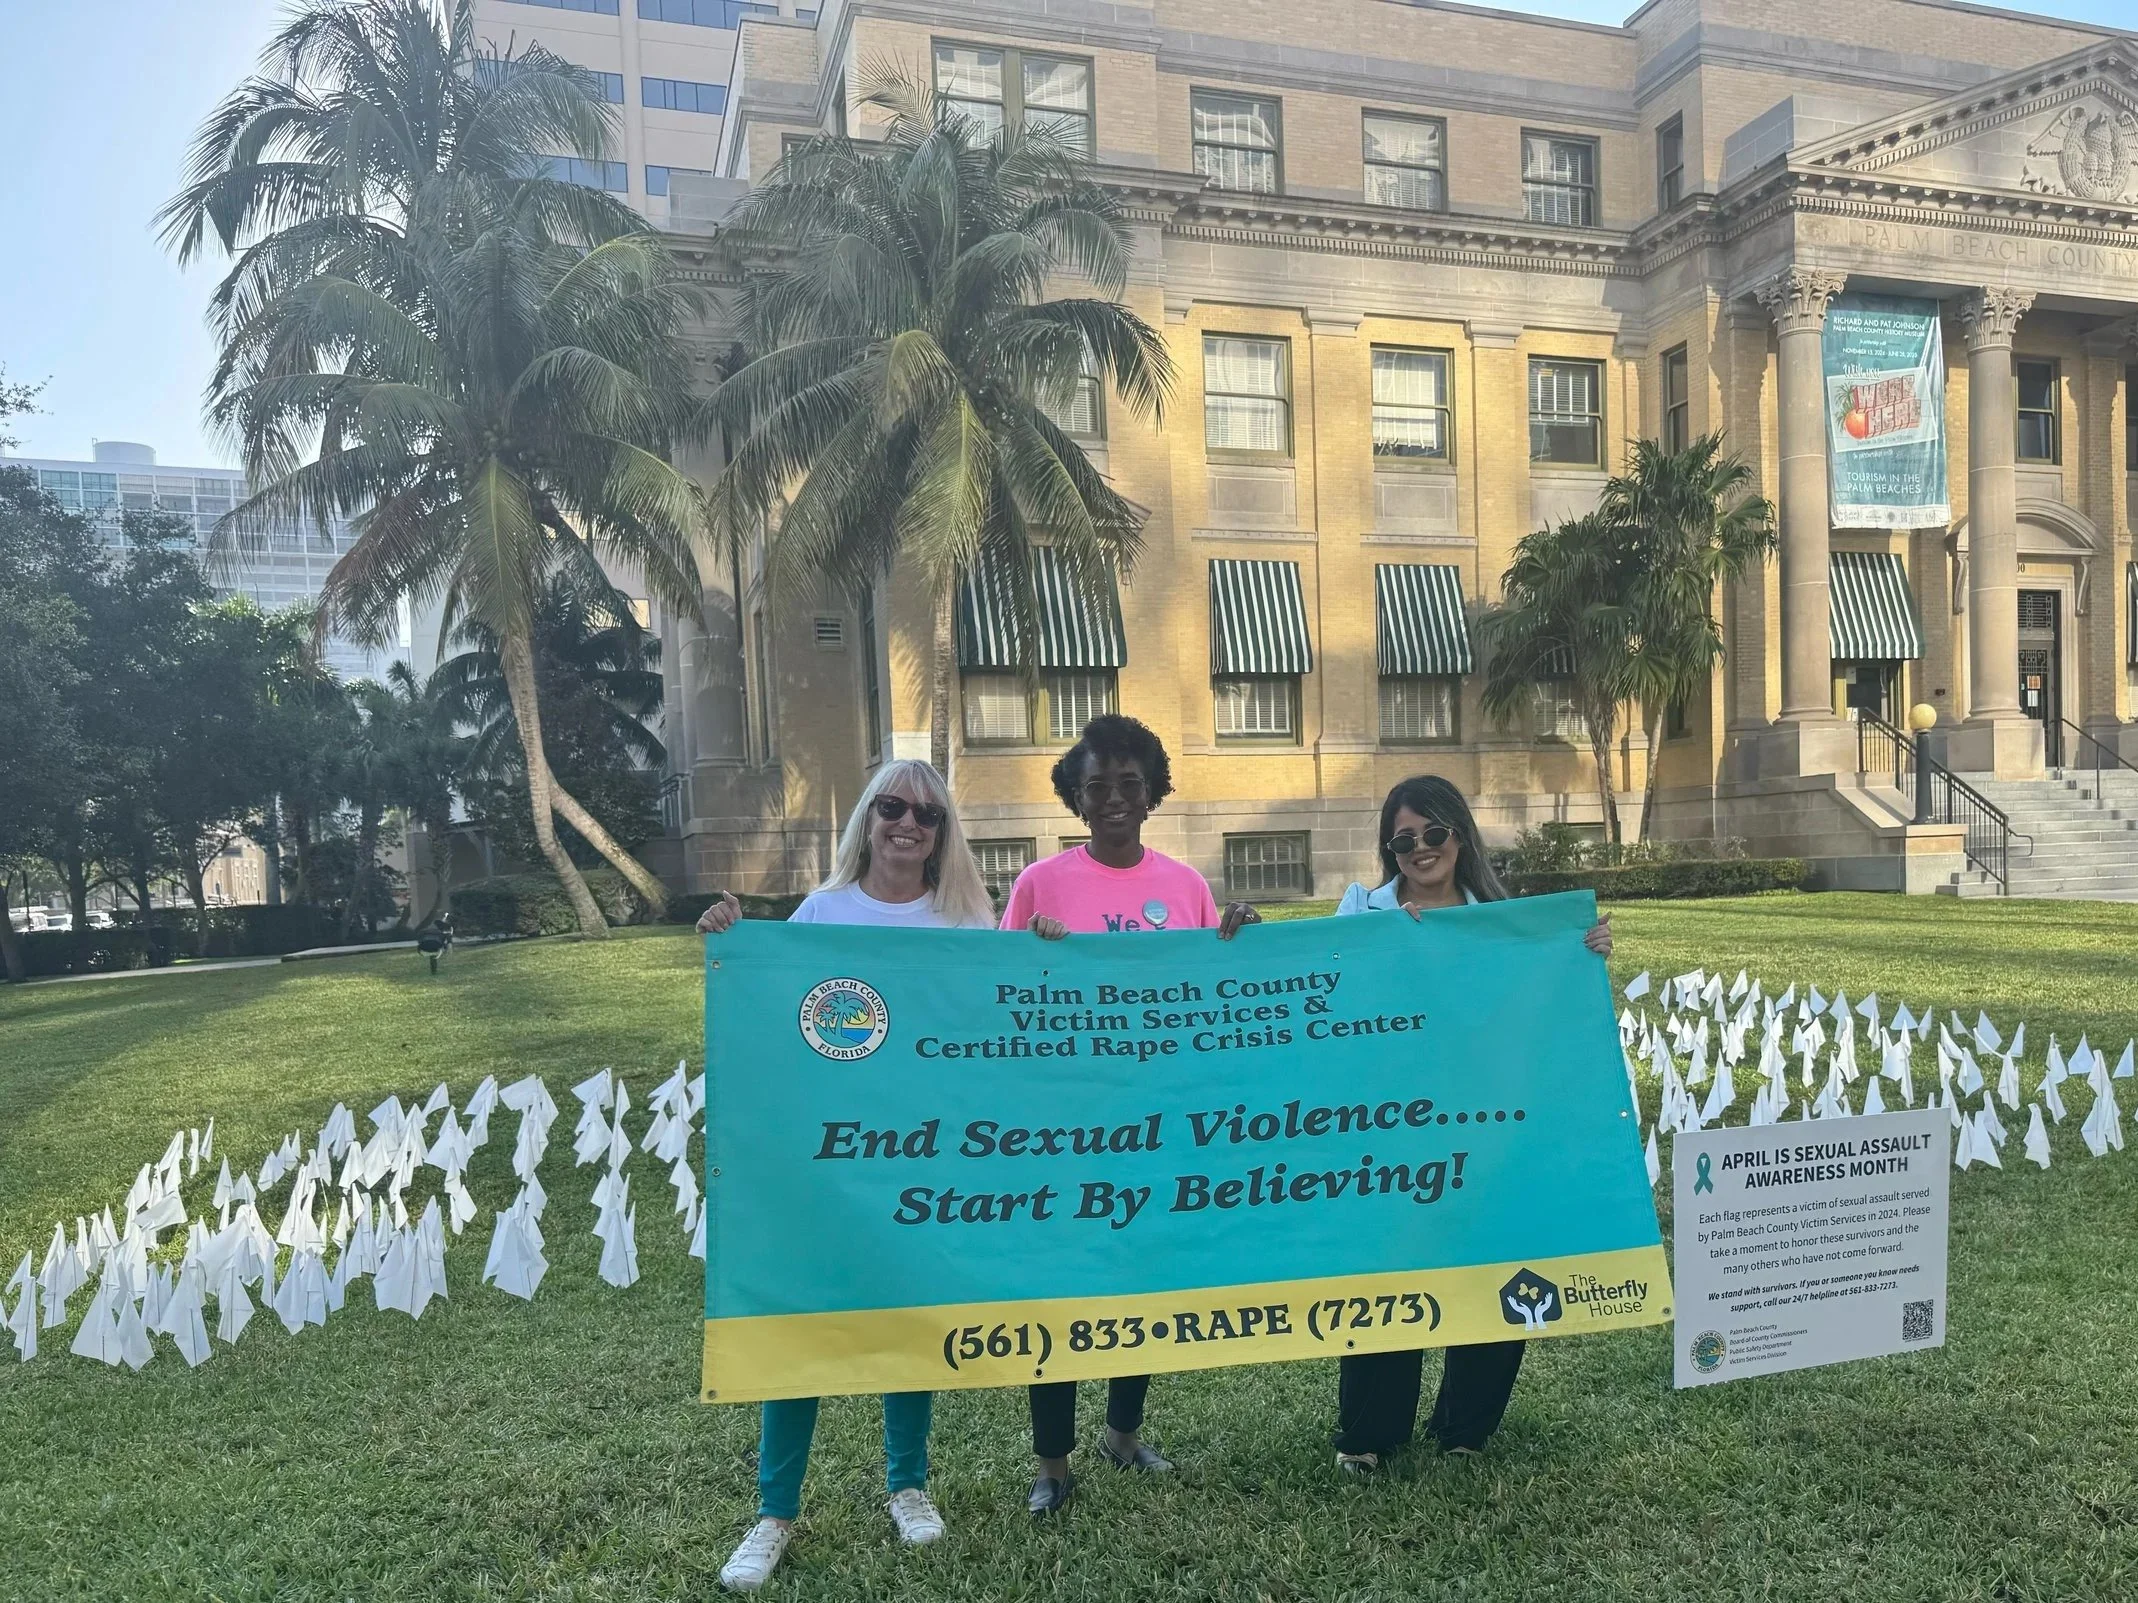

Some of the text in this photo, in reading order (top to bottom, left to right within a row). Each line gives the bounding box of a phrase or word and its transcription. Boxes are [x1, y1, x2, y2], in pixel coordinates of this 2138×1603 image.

[1865, 225, 2136, 273] PALM BEACH COUNTY
[1833, 316, 1925, 330] RICHARD AND PAT JOHNSON
[1847, 472, 1920, 483] TOURISM IN THE
[1847, 483, 1921, 494] PALM BEACHES
[1101, 914, 1141, 932] We
[802, 980, 886, 1024] PALM BEACH COUNTY
[995, 970, 1341, 1005] Palm Beach County
[1009, 994, 1333, 1032] Victim Services &
[818, 1042, 871, 1059] FLORIDA
[915, 1012, 1427, 1062] Certified Rape Crisis Center
[812, 1118, 941, 1160] End
[959, 1112, 1163, 1158] Sexual
[1721, 1134, 1931, 1170] APRIL IS SEXUAL ASSAULT
[1745, 1157, 1908, 1189] AWARENESS MONTH
[892, 1152, 1469, 1230] Start By Believing!
[1699, 1187, 1930, 1224] Each flag represents a victim of sexual assault served
[1698, 1206, 1931, 1244] by Palm Beach County Victim Services in 2024. Please
[1710, 1223, 1919, 1259] take a moment to honor these survivors and the
[1723, 1241, 1904, 1275] many others who have not come forward.
[1563, 1279, 1648, 1304] Butterfly
[1569, 1274, 1597, 1287] The
[1708, 1293, 1720, 1301] We
[1721, 1288, 1743, 1299] stand
[1744, 1286, 1760, 1296] with
[1762, 1282, 1798, 1294] survivors.
[1799, 1279, 1807, 1288] If
[1807, 1279, 1820, 1289] you
[1830, 1273, 1863, 1284] someone
[1863, 1271, 1877, 1281] you
[1878, 1269, 1898, 1278] know
[1898, 1264, 1920, 1274] needs
[1730, 1281, 1898, 1312] support, call our 24/7 helpline at 561-833-7273.
[1589, 1301, 1643, 1317] House
[943, 1322, 1052, 1371] (561)
[1307, 1291, 1442, 1341] (7273)
[1729, 1351, 1787, 1365] Victim Services Division
